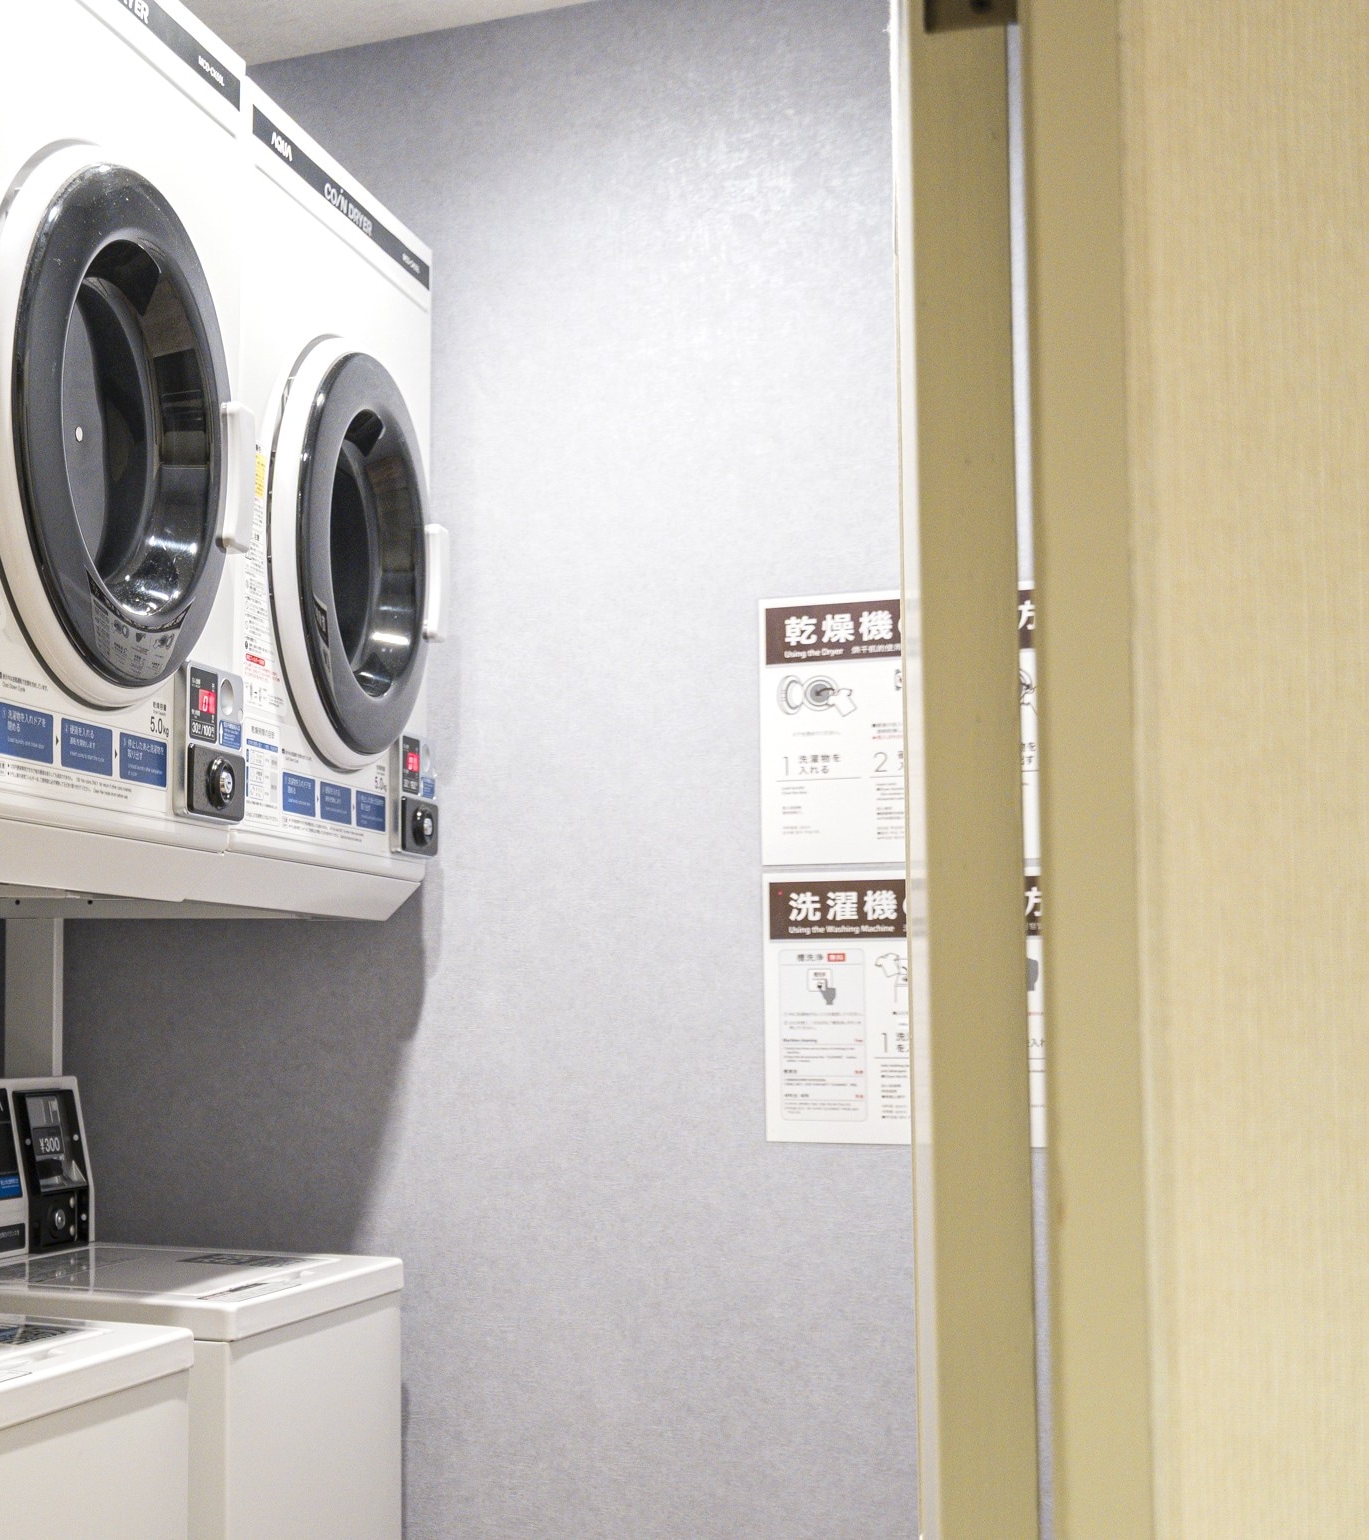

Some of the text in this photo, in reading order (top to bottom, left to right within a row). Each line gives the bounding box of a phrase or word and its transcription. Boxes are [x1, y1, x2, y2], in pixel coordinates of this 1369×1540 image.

[271, 132, 292, 161] AQUA
[348, 203, 372, 236] DRYER
[784, 610, 901, 646] 乾燥機
[784, 647, 844, 659] Using the Dryer
[799, 754, 841, 765] 洗濯物を
[873, 751, 888, 773] 2
[799, 765, 829, 776] 入れる
[788, 890, 906, 921] 洗濯機
[788, 924, 895, 935] Using the Washing Machine
[39, 1137, 60, 1153] ¥300
